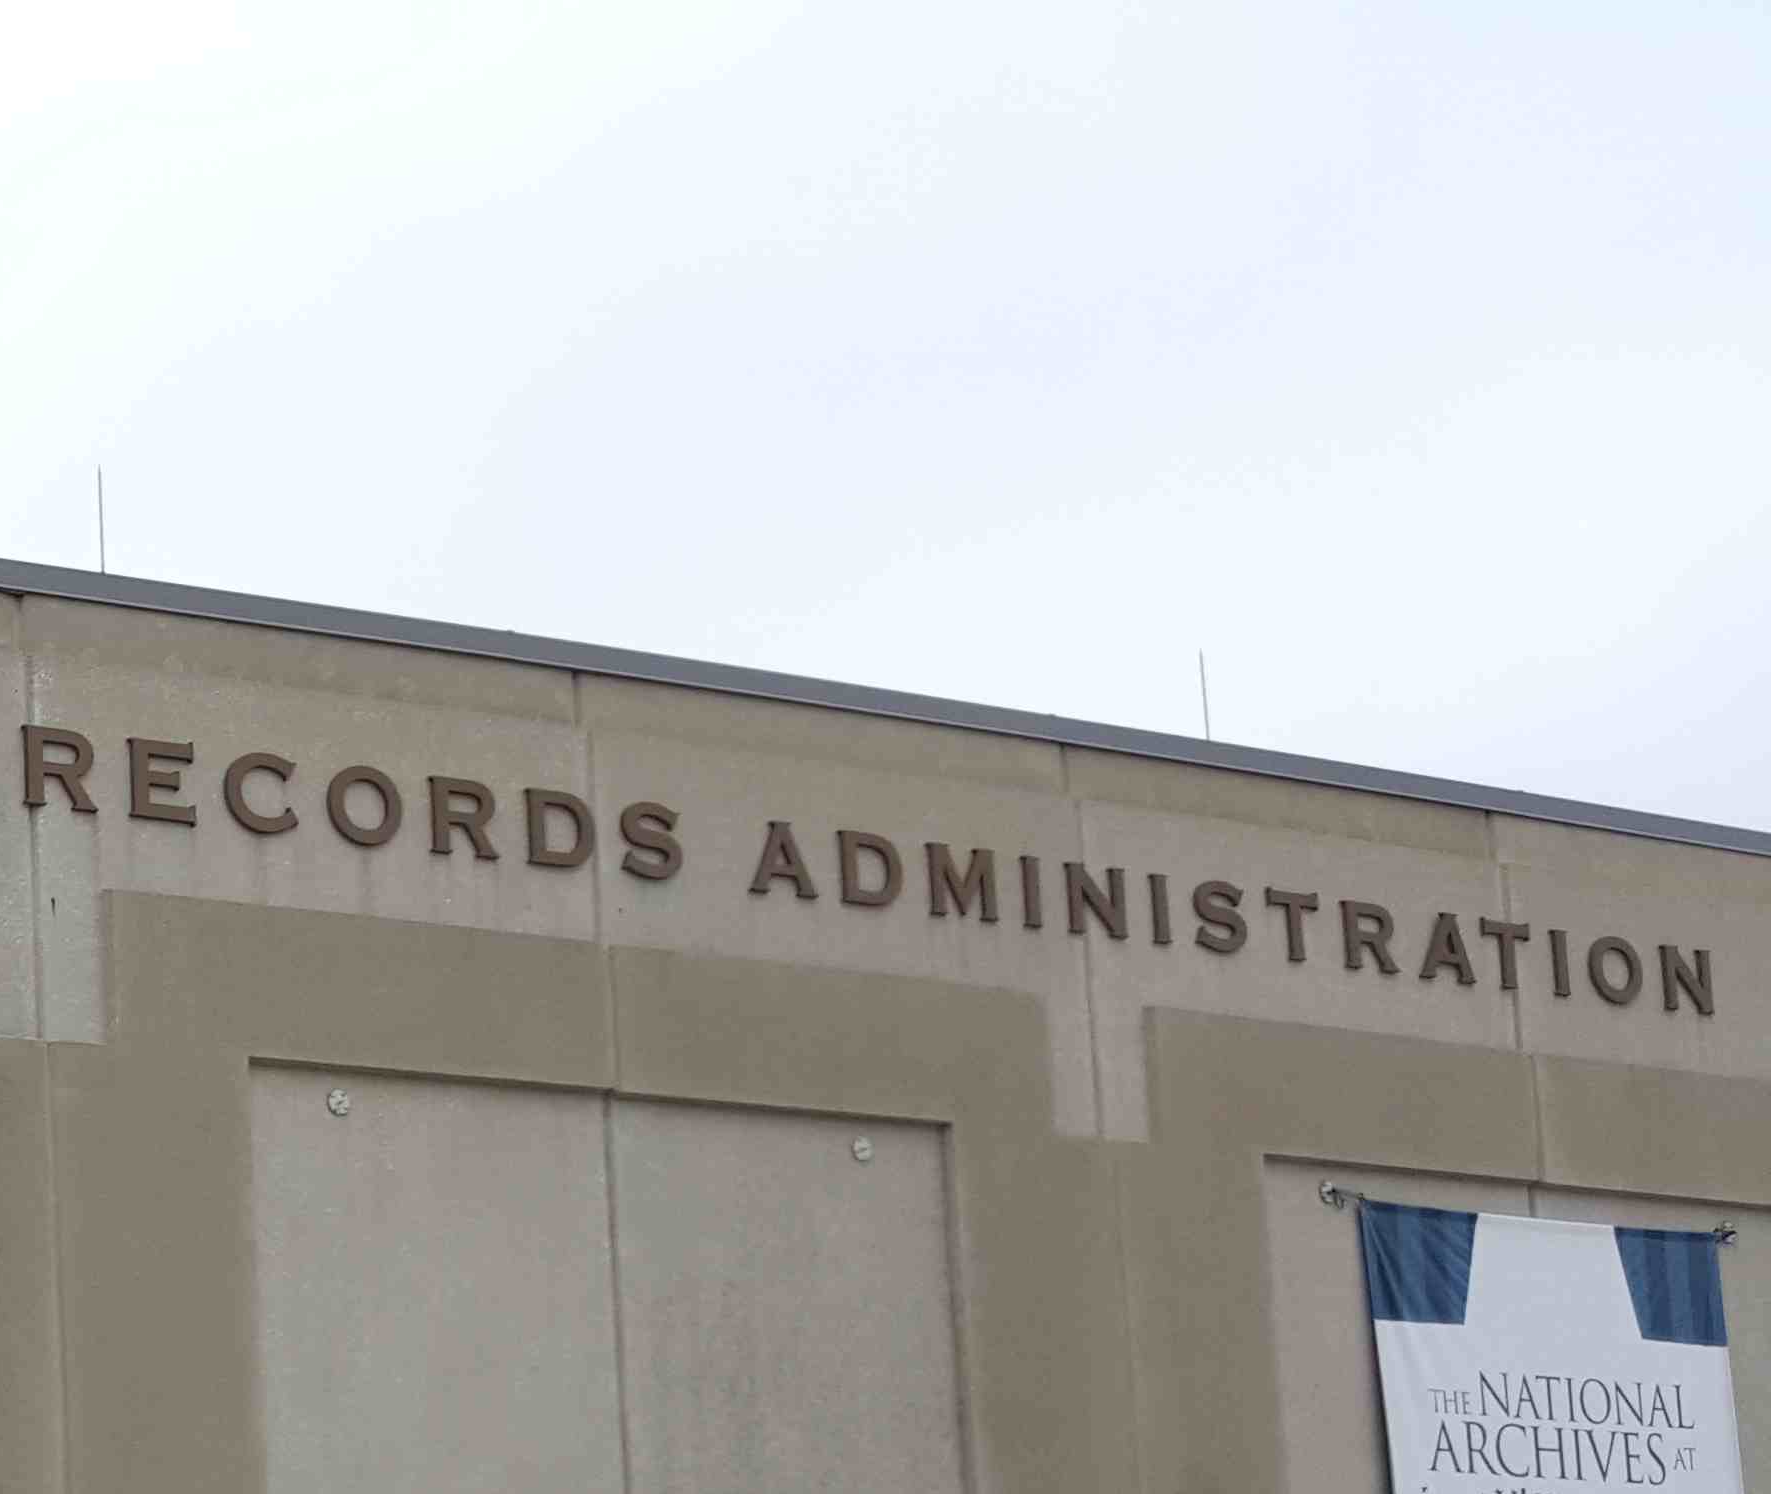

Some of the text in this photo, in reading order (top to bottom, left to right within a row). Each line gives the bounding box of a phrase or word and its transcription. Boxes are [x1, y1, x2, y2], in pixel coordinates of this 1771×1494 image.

[21, 724, 685, 880] RECORDS
[749, 820, 1717, 1016] ADMINISTRATION
[1427, 1370, 1696, 1430] THE NATIONAL
[1428, 1419, 1697, 1486] ARCHIVES AT
